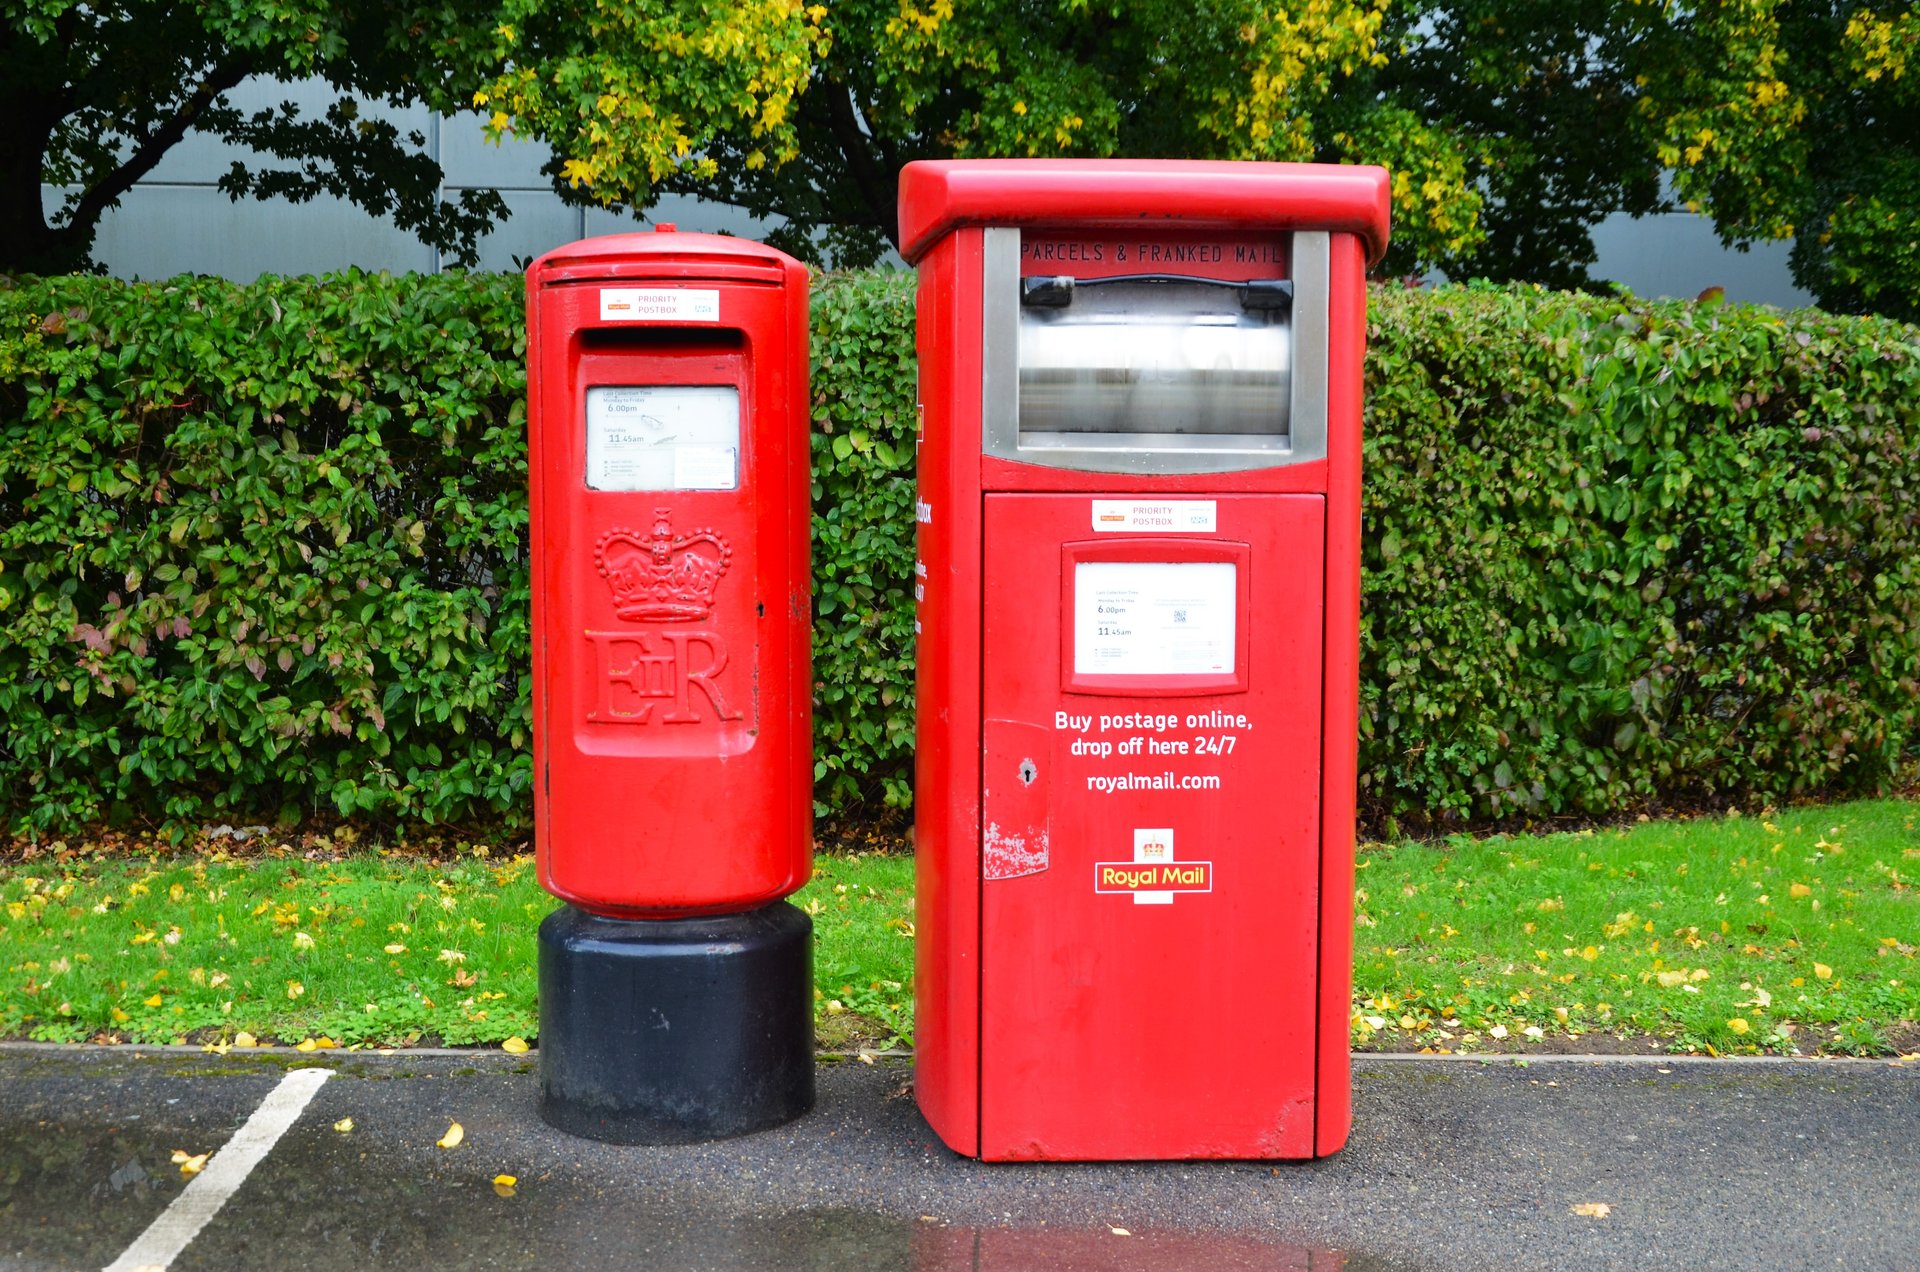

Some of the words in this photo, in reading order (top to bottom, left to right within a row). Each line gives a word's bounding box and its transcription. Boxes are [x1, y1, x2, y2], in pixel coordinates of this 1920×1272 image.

[1020, 243, 1103, 260] PARCELS
[1117, 244, 1127, 261] &
[1139, 244, 1222, 262] FRANKED
[1236, 246, 1281, 264] MAIL
[638, 295, 677, 303] PRIORITY
[638, 306, 677, 314] POSTBOX
[1132, 506, 1173, 515] PRIORITY
[1132, 517, 1173, 526] POSTBOX
[1097, 605, 1126, 614] 6.00pm
[1098, 627, 1132, 636] 11.45am
[1055, 711, 1093, 733] Buy
[1099, 712, 1178, 732] postage
[1186, 710, 1253, 730] online,
[1071, 737, 1112, 759] drop
[1118, 736, 1145, 755] off
[1149, 737, 1189, 755] here
[1195, 734, 1237, 756] 24/7
[1087, 771, 1221, 794] royalmail.com
[1103, 867, 1157, 888] Royal
[1162, 867, 1205, 885] Mail
